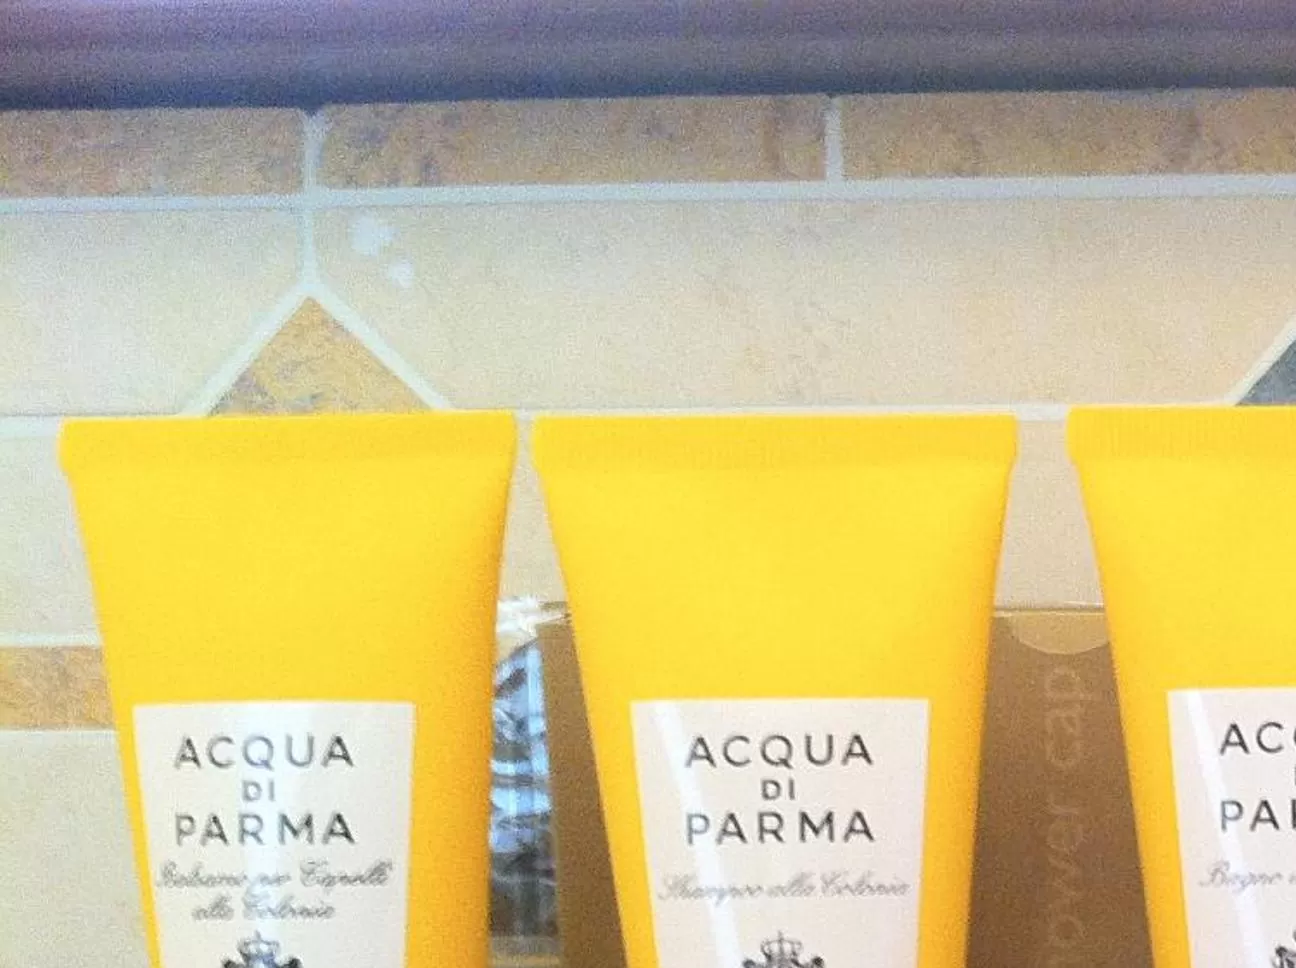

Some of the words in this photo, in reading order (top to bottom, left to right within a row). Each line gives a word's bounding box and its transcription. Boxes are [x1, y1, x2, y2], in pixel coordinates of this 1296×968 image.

[1044, 664, 1101, 770] cap
[174, 734, 355, 770] ACQUA
[685, 733, 874, 769] ACQUA
[242, 779, 276, 802] DI
[760, 778, 796, 802] DI
[175, 812, 357, 847] PARMA
[686, 810, 876, 846] PARMA
